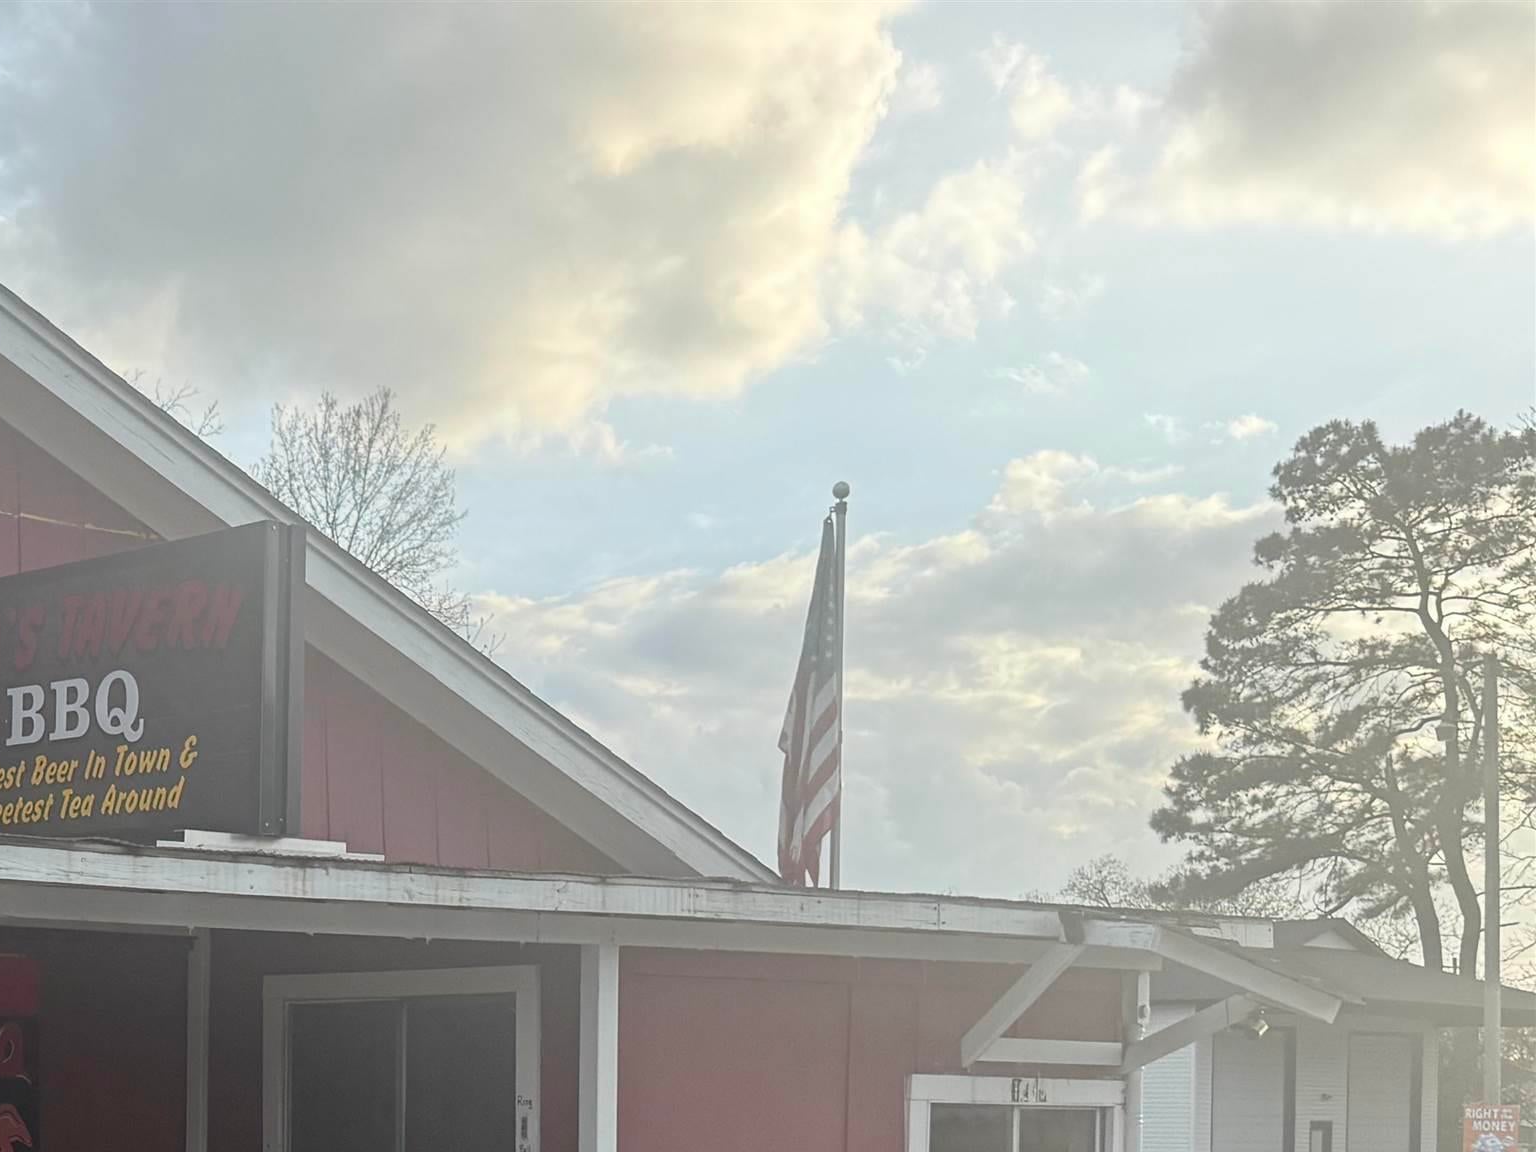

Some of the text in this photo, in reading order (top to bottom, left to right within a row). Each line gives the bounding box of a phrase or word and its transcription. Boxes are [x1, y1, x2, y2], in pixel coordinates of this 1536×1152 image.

[56, 577, 244, 662] TAVERN
[5, 669, 145, 746] BBQ
[30, 754, 79, 786] Beer
[84, 749, 107, 780] In
[114, 743, 171, 777] Town
[178, 734, 199, 769] &
[58, 787, 96, 819] Tea
[100, 775, 186, 816] Around
[1465, 1107, 1499, 1119] RIGHT
[1472, 1120, 1515, 1132] MONEY
